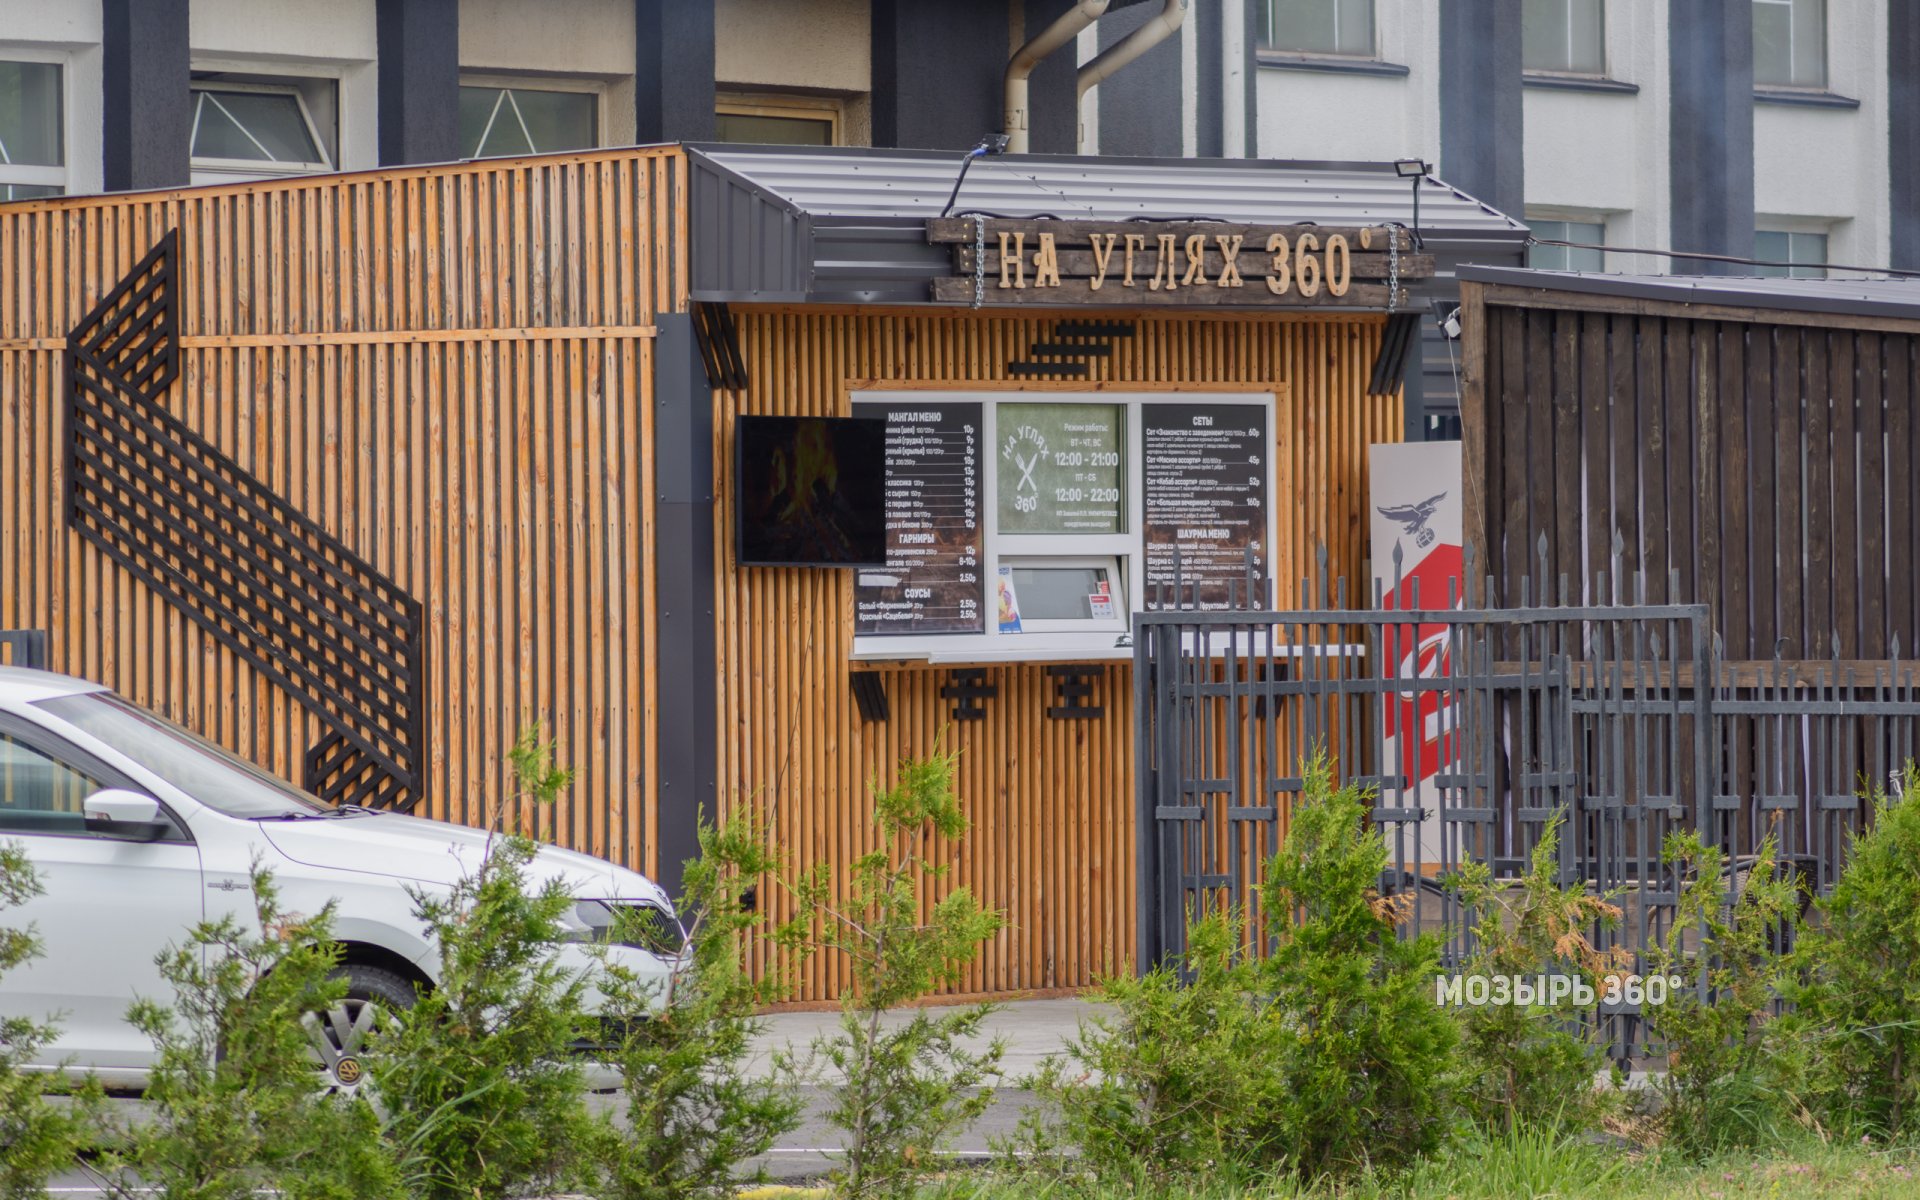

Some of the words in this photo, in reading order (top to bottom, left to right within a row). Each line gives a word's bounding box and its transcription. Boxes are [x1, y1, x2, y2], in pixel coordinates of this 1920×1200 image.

[997, 231, 1062, 289] НА
[1088, 232, 1245, 292] УГЛЯХ
[1265, 226, 1372, 298] 360°
[888, 412, 918, 422] МАНГАЛ
[919, 412, 942, 422] МЕНЮ
[1193, 416, 1213, 426] СЕТЫ
[963, 425, 974, 434] 10р
[1064, 423, 1084, 432] Режим
[1248, 428, 1260, 437] 60р
[966, 435, 974, 445] 9р
[1002, 435, 1017, 460] НА
[1017, 425, 1050, 460] УГЛЯХ
[966, 446, 974, 455] 8р
[1054, 452, 1082, 466] 12:00
[1091, 452, 1118, 466] 21:00
[1248, 456, 1260, 465] 45р
[964, 467, 974, 476] 13р
[964, 477, 974, 487] 13р
[1248, 477, 1260, 486] 52р
[964, 488, 975, 497] 14р
[1055, 488, 1082, 501] 12:00
[1090, 488, 1118, 502] 22:00
[964, 498, 975, 508] 14р
[1246, 498, 1260, 508] 160р
[964, 508, 975, 518] 15р
[965, 519, 975, 528] 12р
[1177, 529, 1207, 538] ШАУРМА
[1208, 529, 1230, 538] МЕНЮ
[899, 534, 935, 544] ГАРНИРЫ
[965, 546, 975, 556] 12р
[959, 556, 976, 566] 8-10р
[904, 588, 930, 598] СОУСЫ
